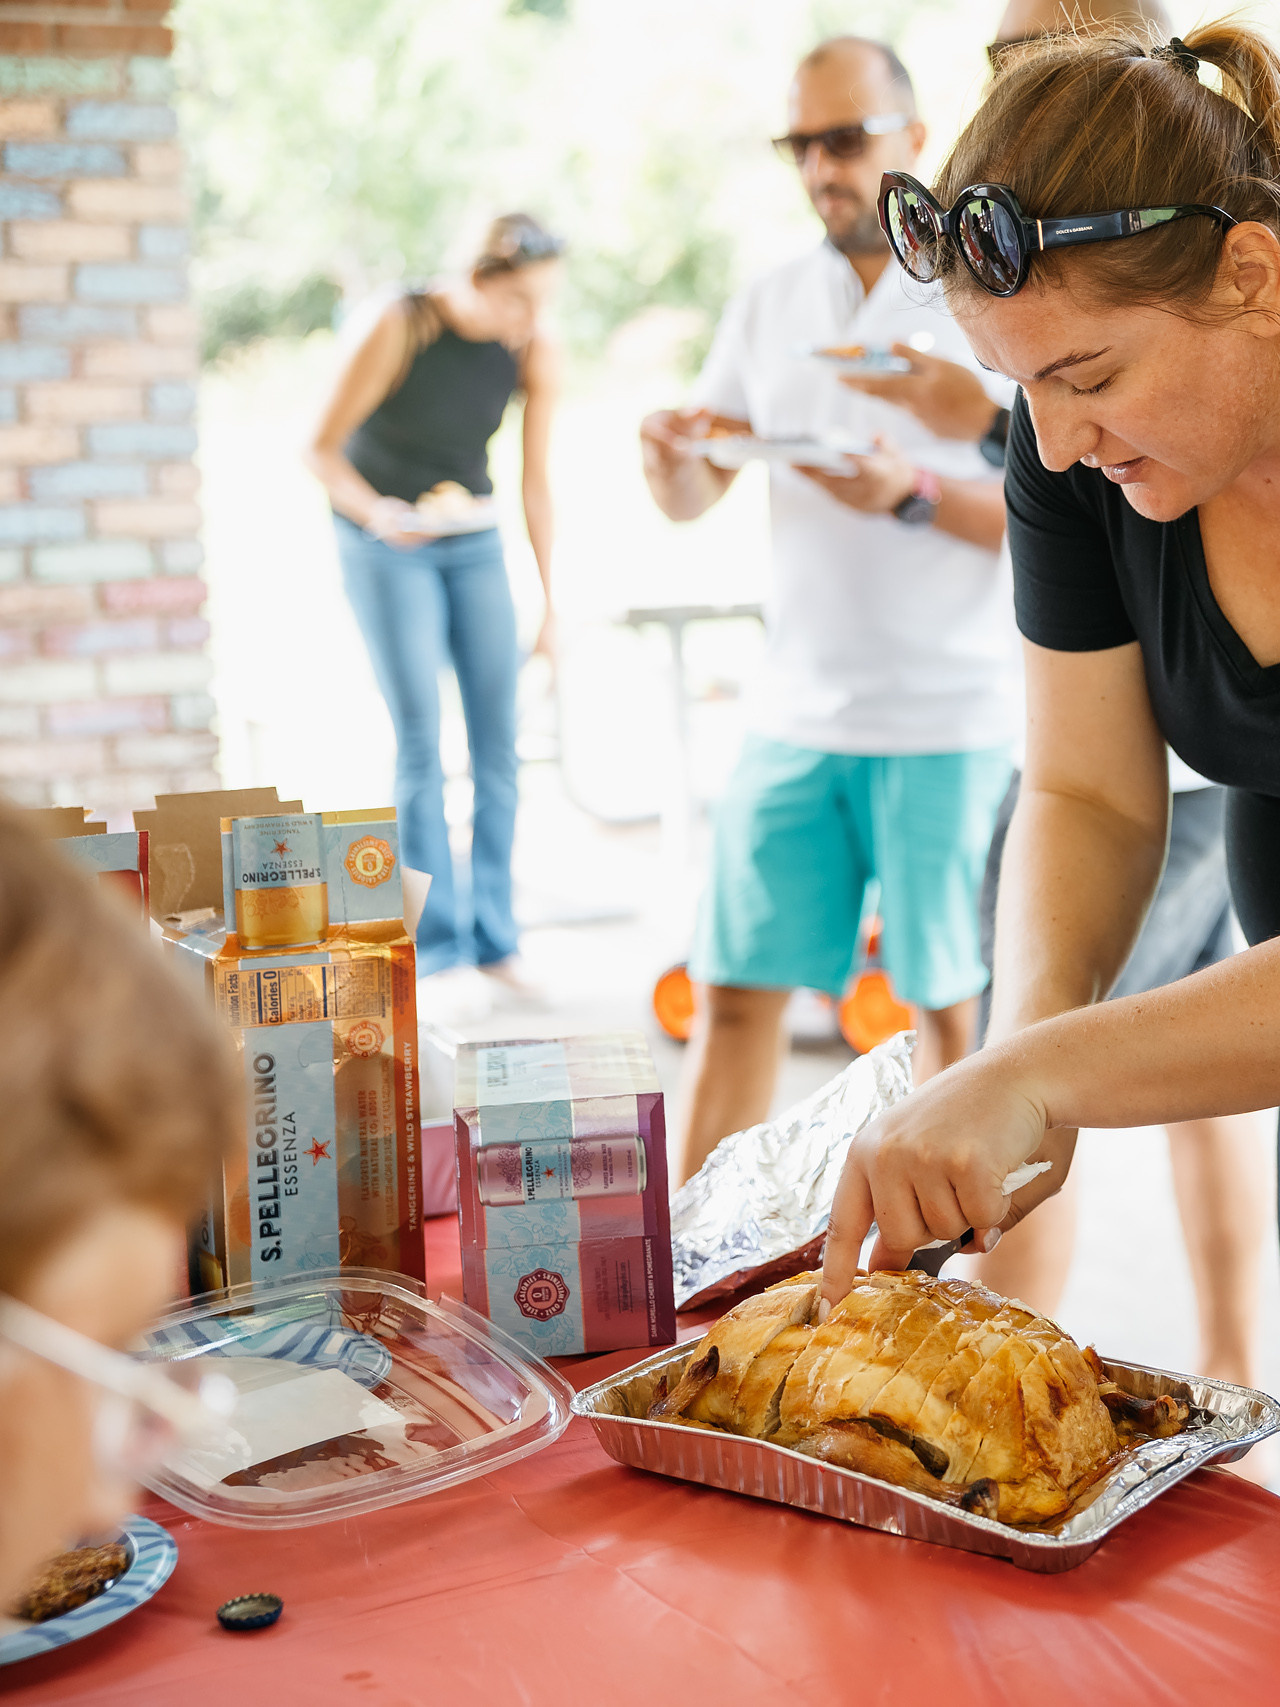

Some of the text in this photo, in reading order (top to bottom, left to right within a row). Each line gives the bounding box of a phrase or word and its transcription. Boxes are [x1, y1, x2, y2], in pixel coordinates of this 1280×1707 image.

[242, 868, 321, 882] S.PELLEGRINO
[262, 860, 302, 870] ESSENZA
[228, 974, 240, 1026] Nutrition Facts
[263, 971, 279, 1023] Calories 0
[368, 1090, 377, 1117] ADDED
[282, 1111, 299, 1196] ESSENZA
[357, 1090, 370, 1200] FLAVORED MINERAL WATER
[369, 1138, 379, 1173] NATURAL
[403, 1041, 417, 1231] TANGERINE & WILD STRAWBERRY
[253, 1052, 283, 1262] S.PELLEGRINO
[526, 1147, 535, 1200] S.PELLEGRINO
[370, 1176, 380, 1198] WITH
[645, 1238, 653, 1274] POMEGRANATE
[519, 1276, 538, 1315] ZERO CALORIES
[647, 1280, 655, 1299] CHERRY
